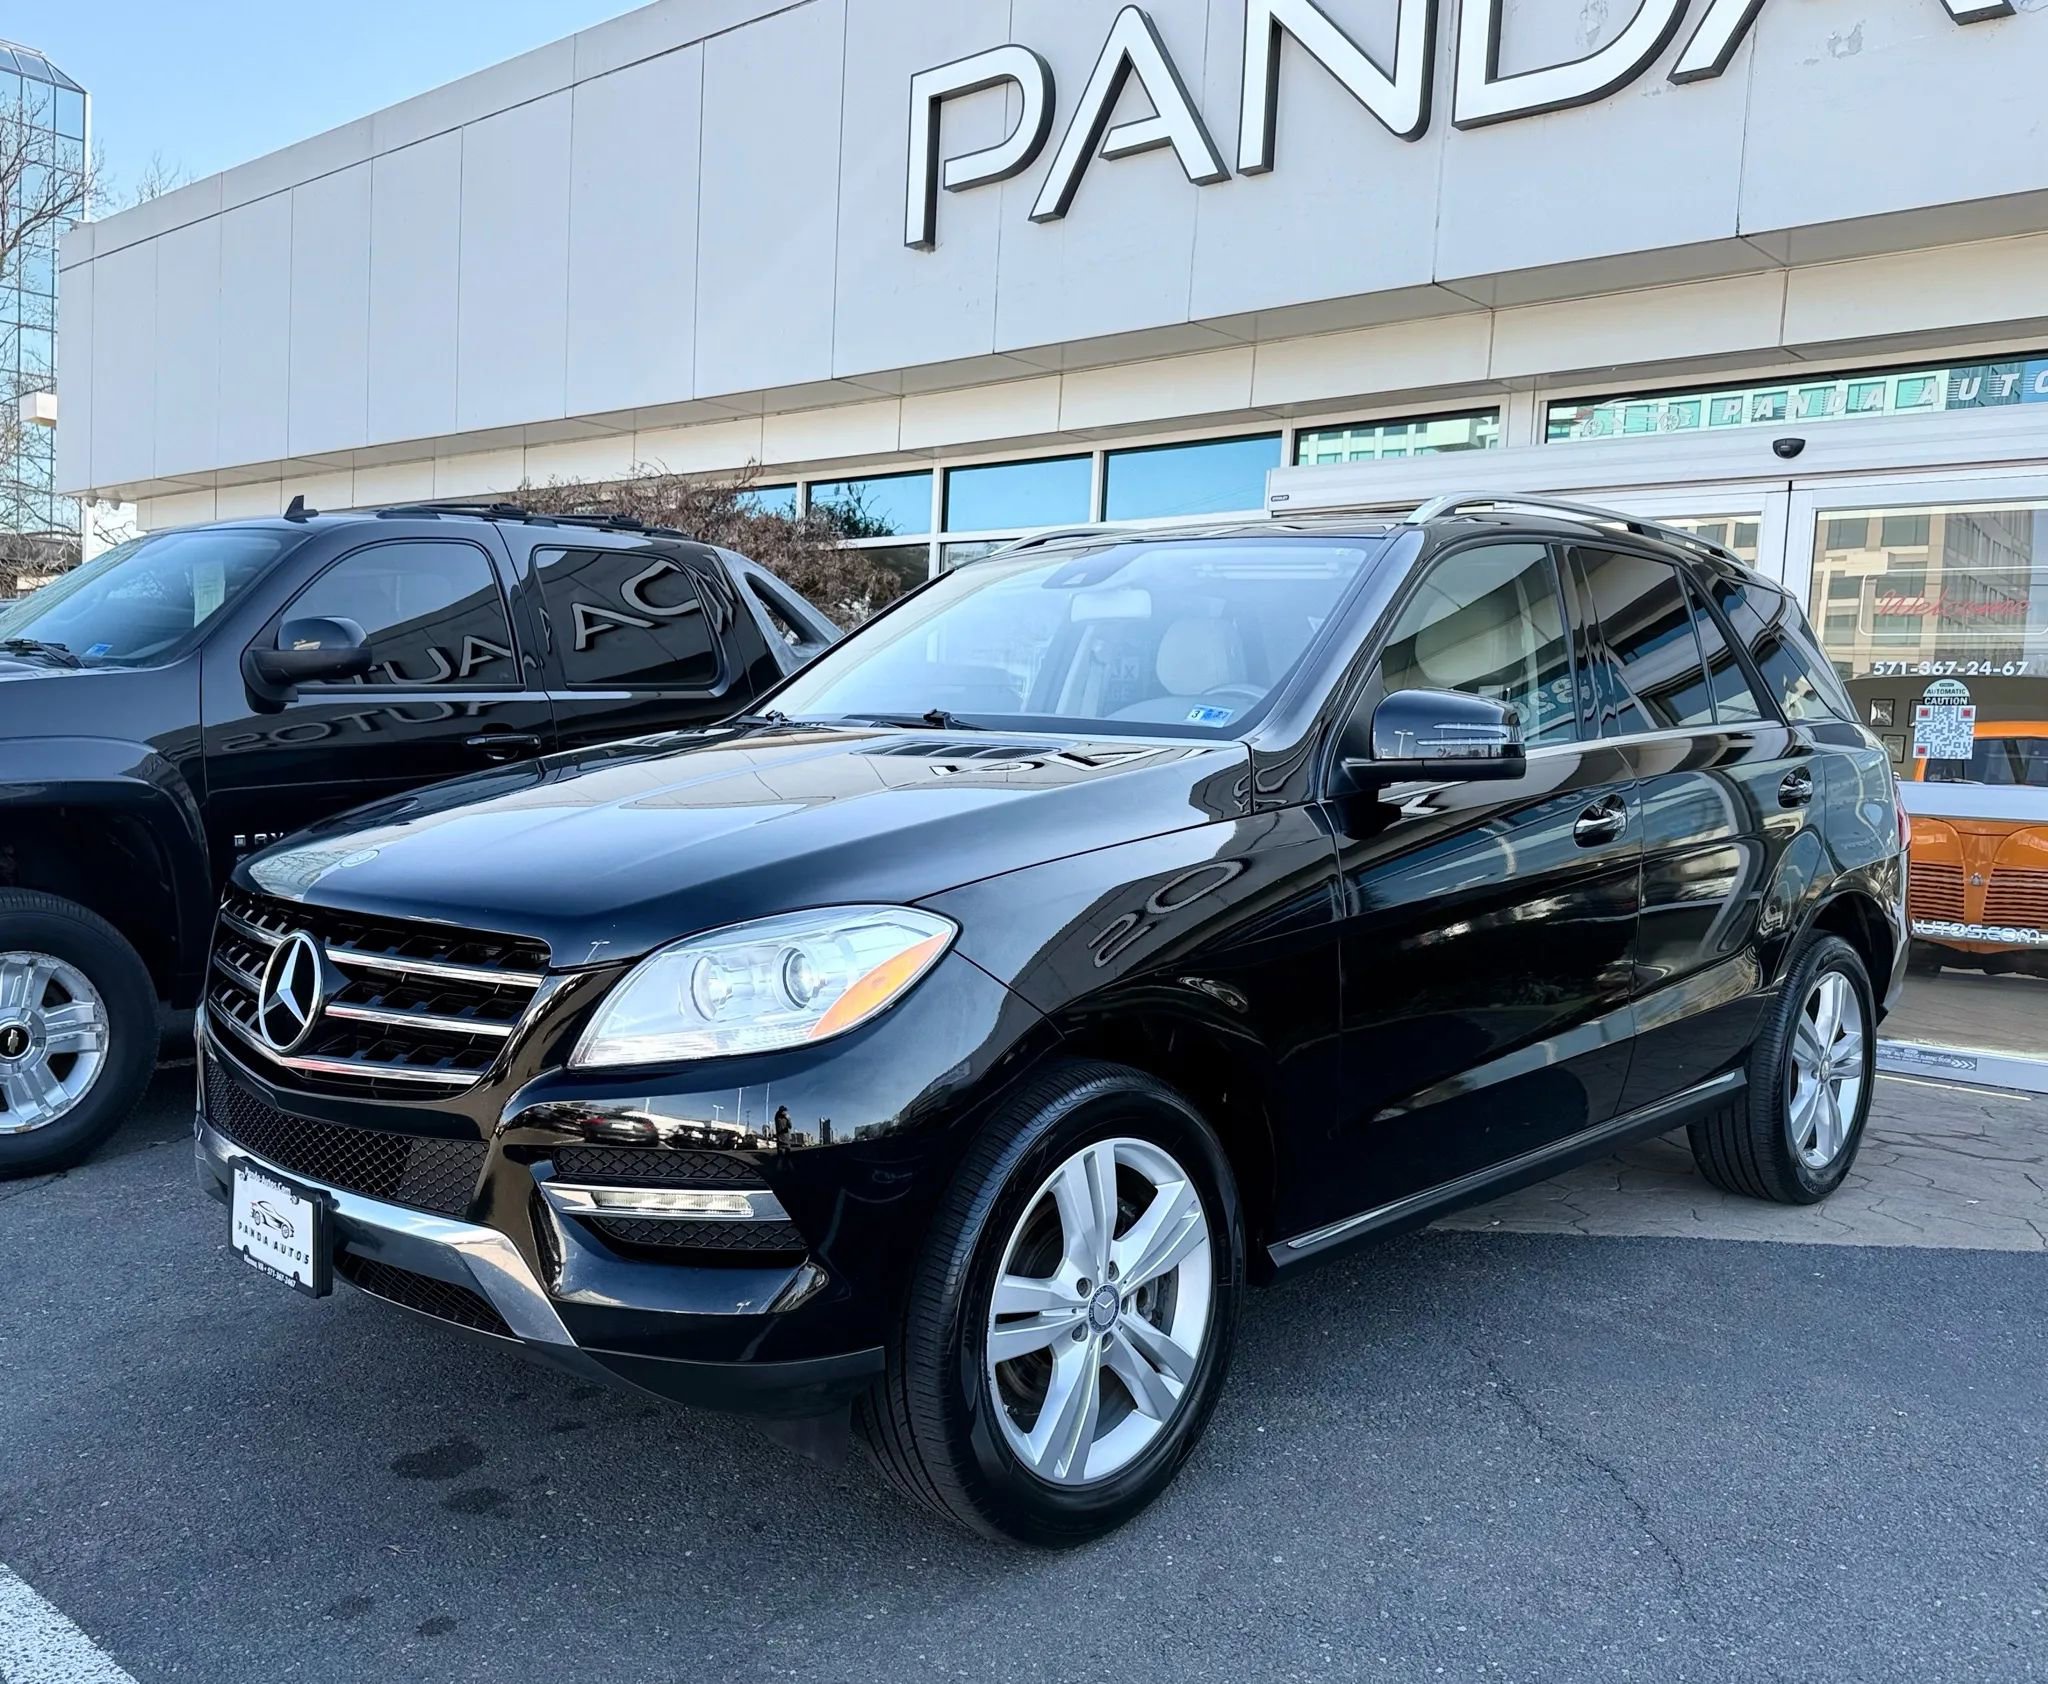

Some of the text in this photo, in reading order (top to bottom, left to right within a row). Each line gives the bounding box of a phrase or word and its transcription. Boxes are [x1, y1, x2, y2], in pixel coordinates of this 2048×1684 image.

[904, 0, 2017, 252] PAND
[1723, 387, 1886, 421] PANDA
[1873, 660, 2029, 677] 571-367-24-67
[1924, 697, 1968, 705] CAUTION
[237, 1220, 269, 1245] PANDA
[273, 1240, 310, 1265] AUTOS
